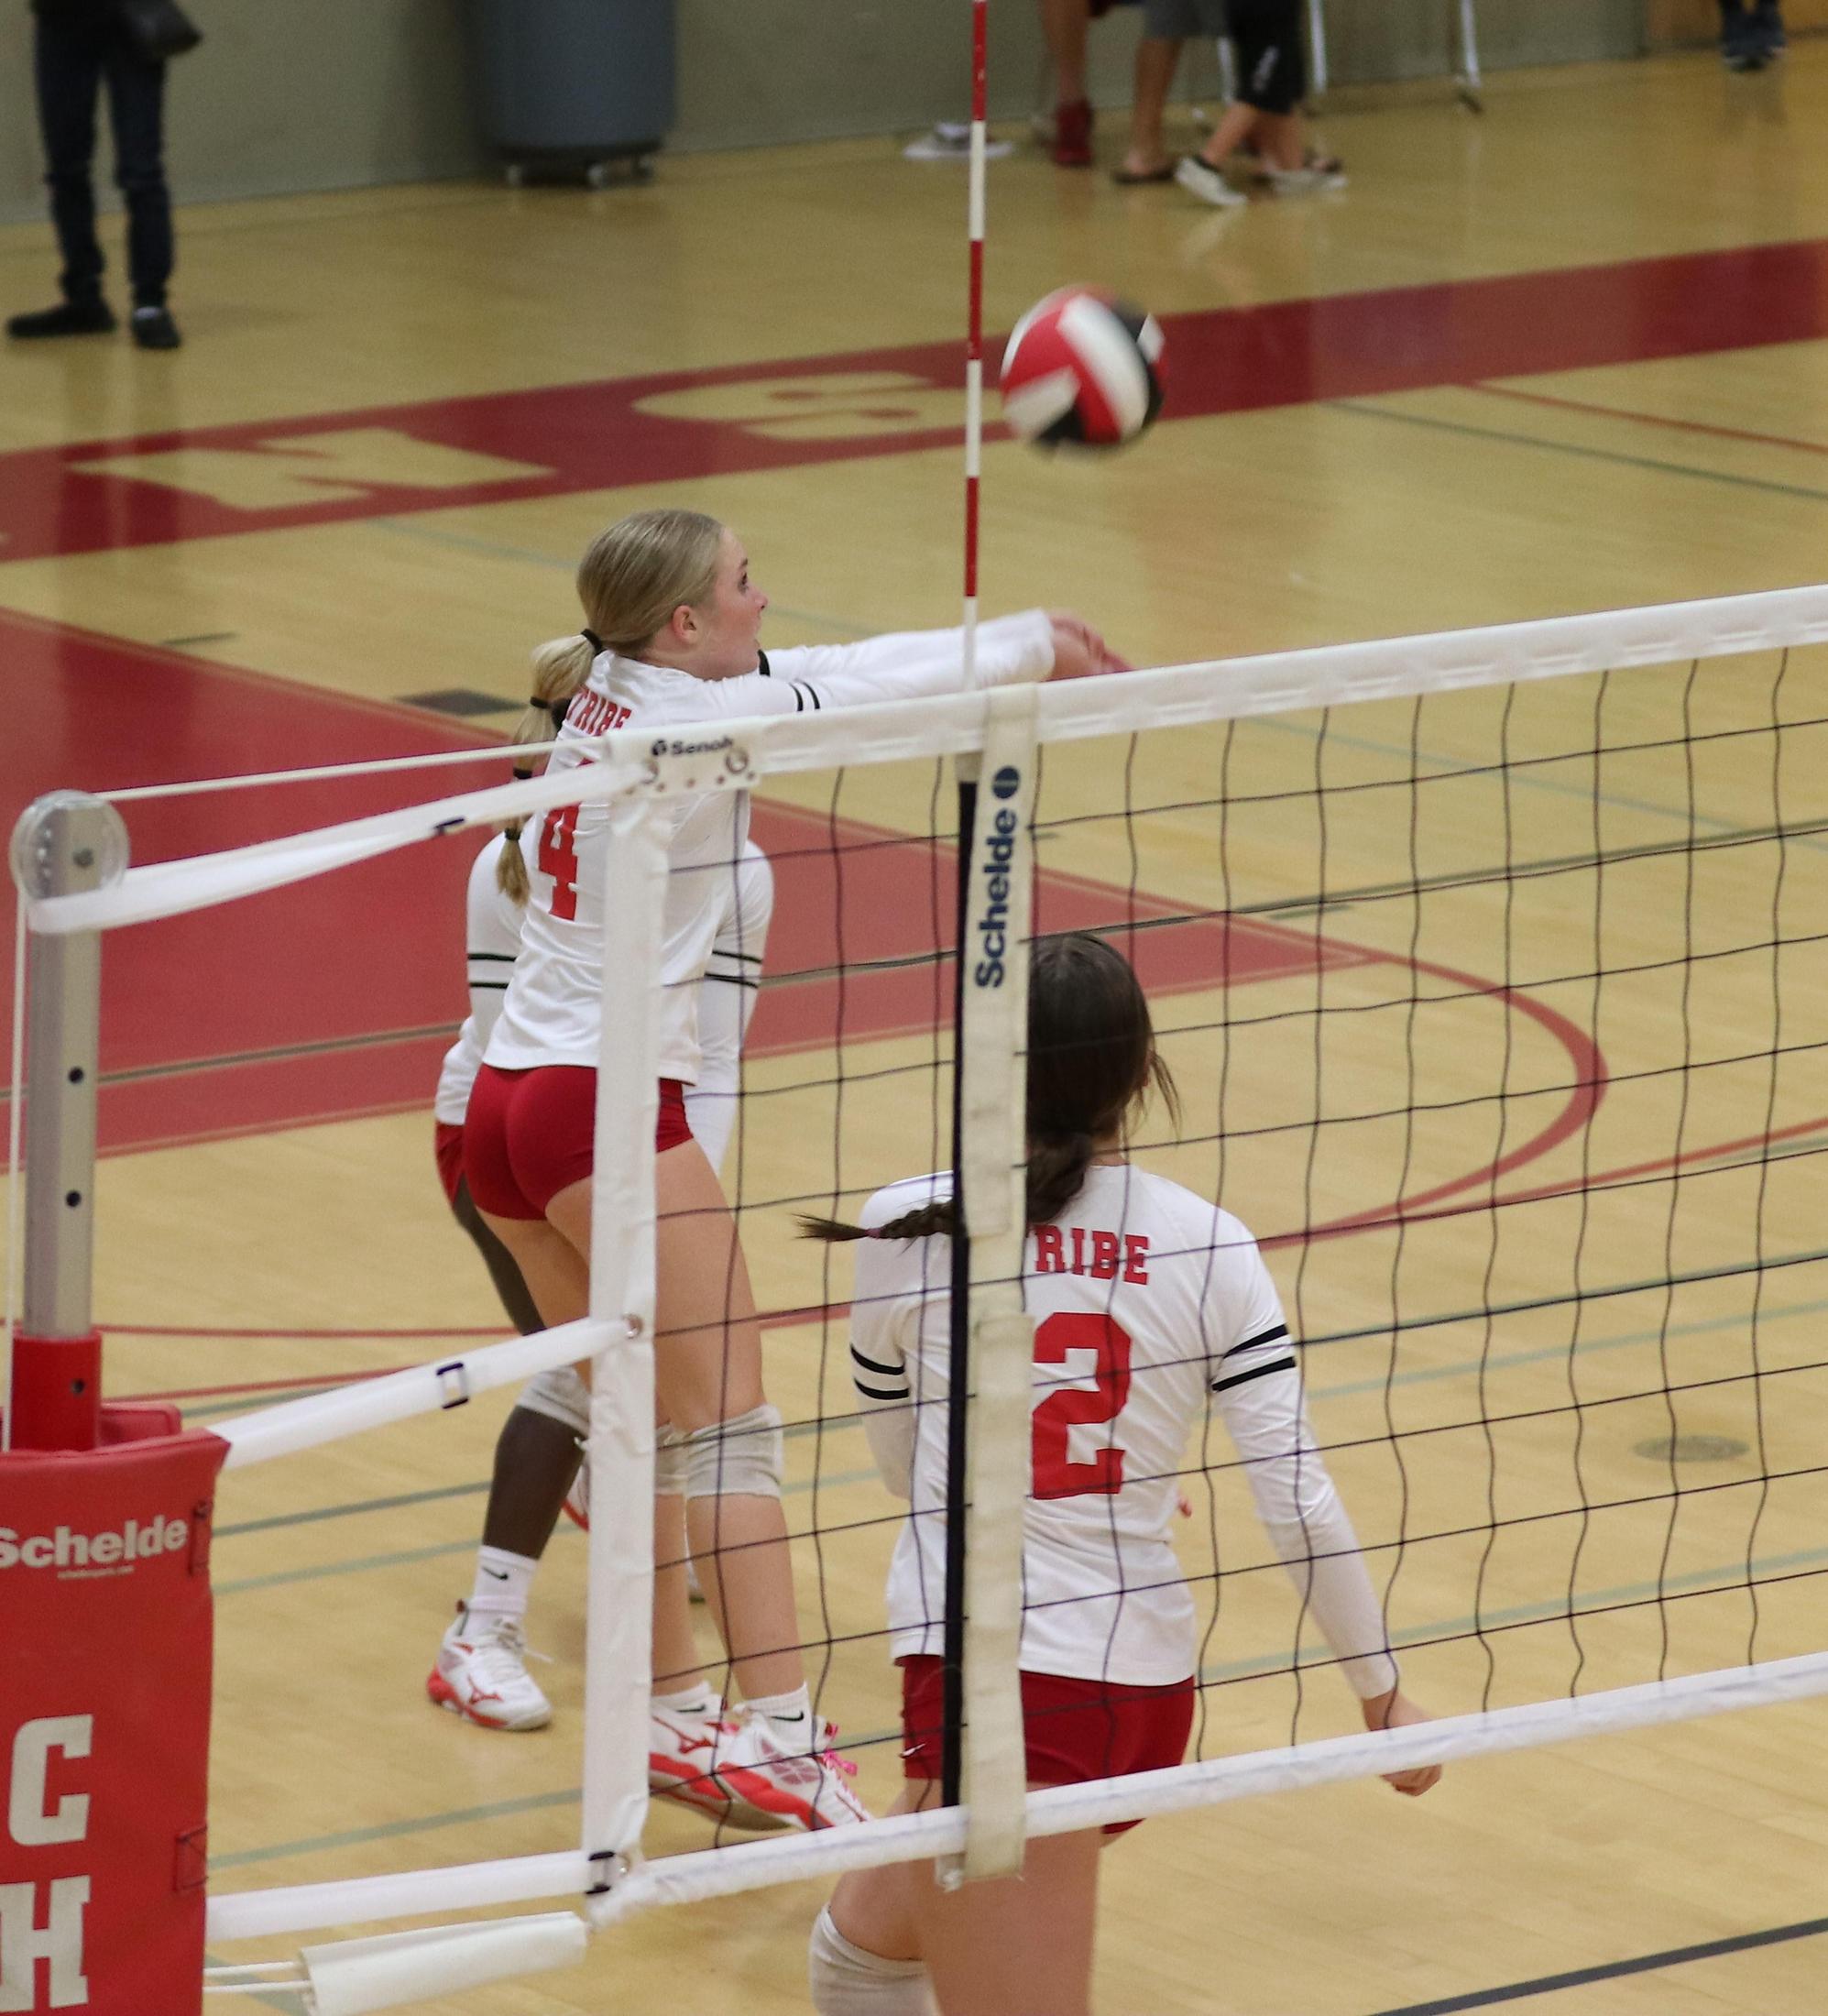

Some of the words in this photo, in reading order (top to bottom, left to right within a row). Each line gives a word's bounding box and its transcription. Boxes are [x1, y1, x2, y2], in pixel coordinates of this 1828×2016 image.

[565, 684, 632, 737] TRIBE
[671, 736, 734, 756] Senoh
[538, 759, 595, 921] 4
[974, 807, 1018, 989] Schelde
[1033, 1223, 1150, 1286] RIBE
[1032, 1311, 1133, 1500] 2
[0, 1514, 189, 1570] Schelde
